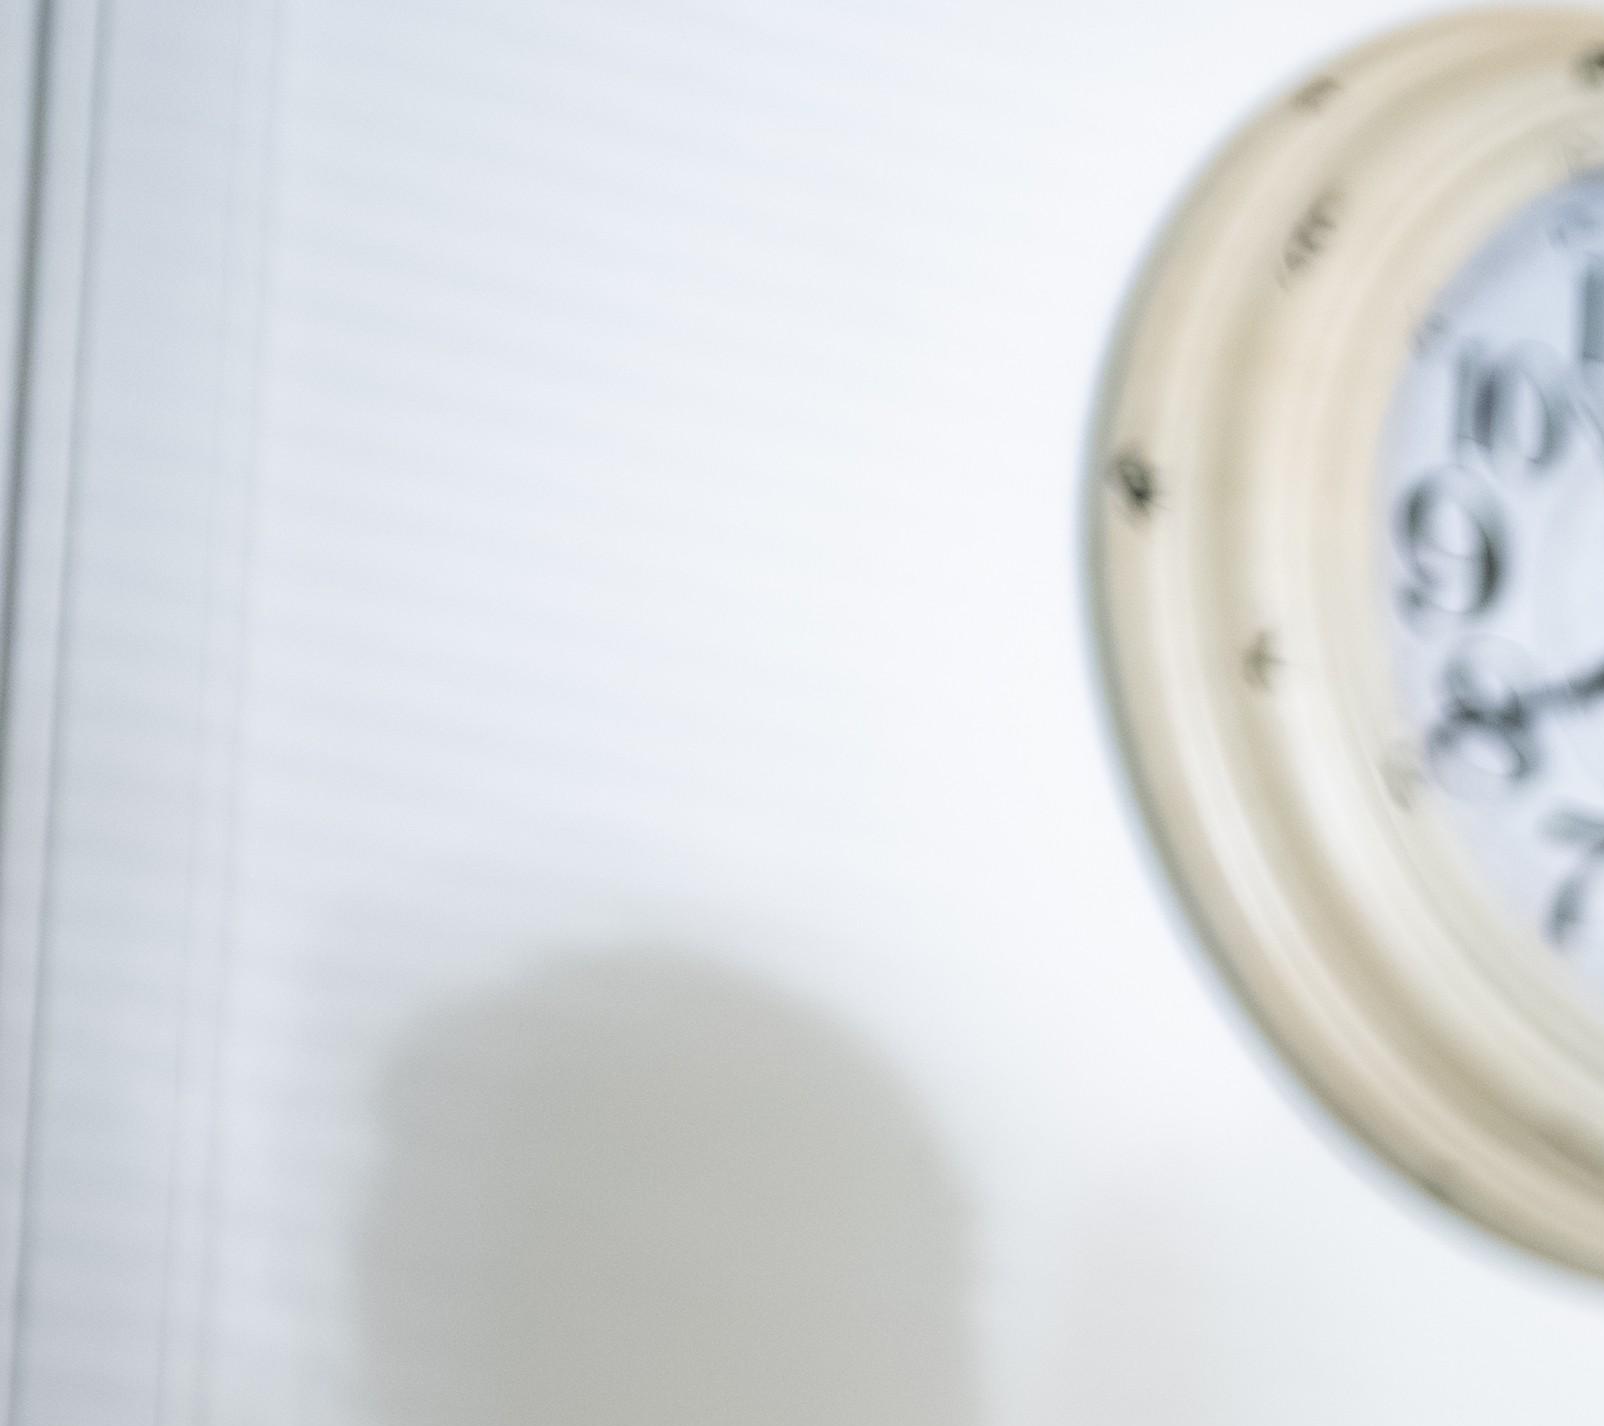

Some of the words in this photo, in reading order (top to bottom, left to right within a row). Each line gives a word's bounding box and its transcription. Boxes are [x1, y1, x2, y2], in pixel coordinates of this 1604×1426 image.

[1456, 345, 1564, 473] 10
[1399, 469, 1502, 629] 9
[1430, 641, 1539, 779] 8
